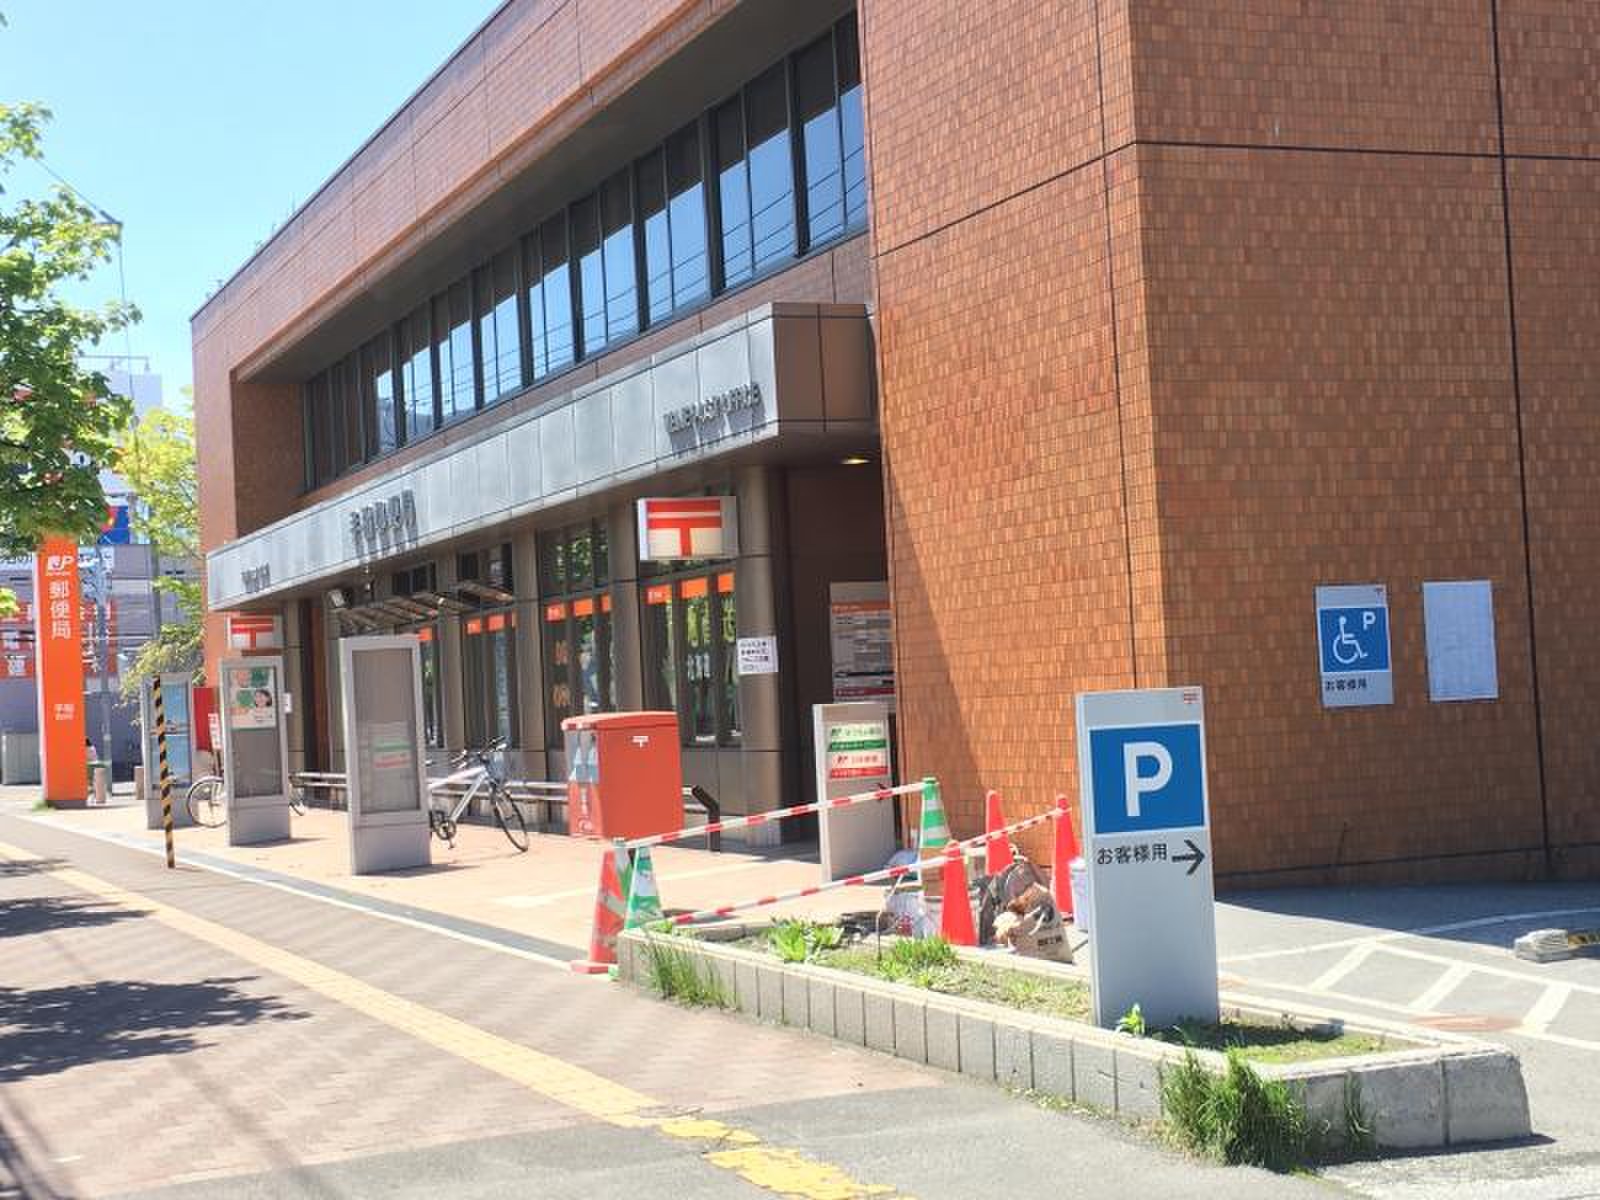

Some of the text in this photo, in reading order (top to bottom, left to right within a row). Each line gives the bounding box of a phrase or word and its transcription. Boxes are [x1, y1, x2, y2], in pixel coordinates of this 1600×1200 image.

[48, 579, 72, 640] 郵便局
[1362, 611, 1377, 631] P
[1324, 678, 1368, 692] お客様用
[1123, 741, 1173, 817] P
[1096, 843, 1168, 865] お客様用
